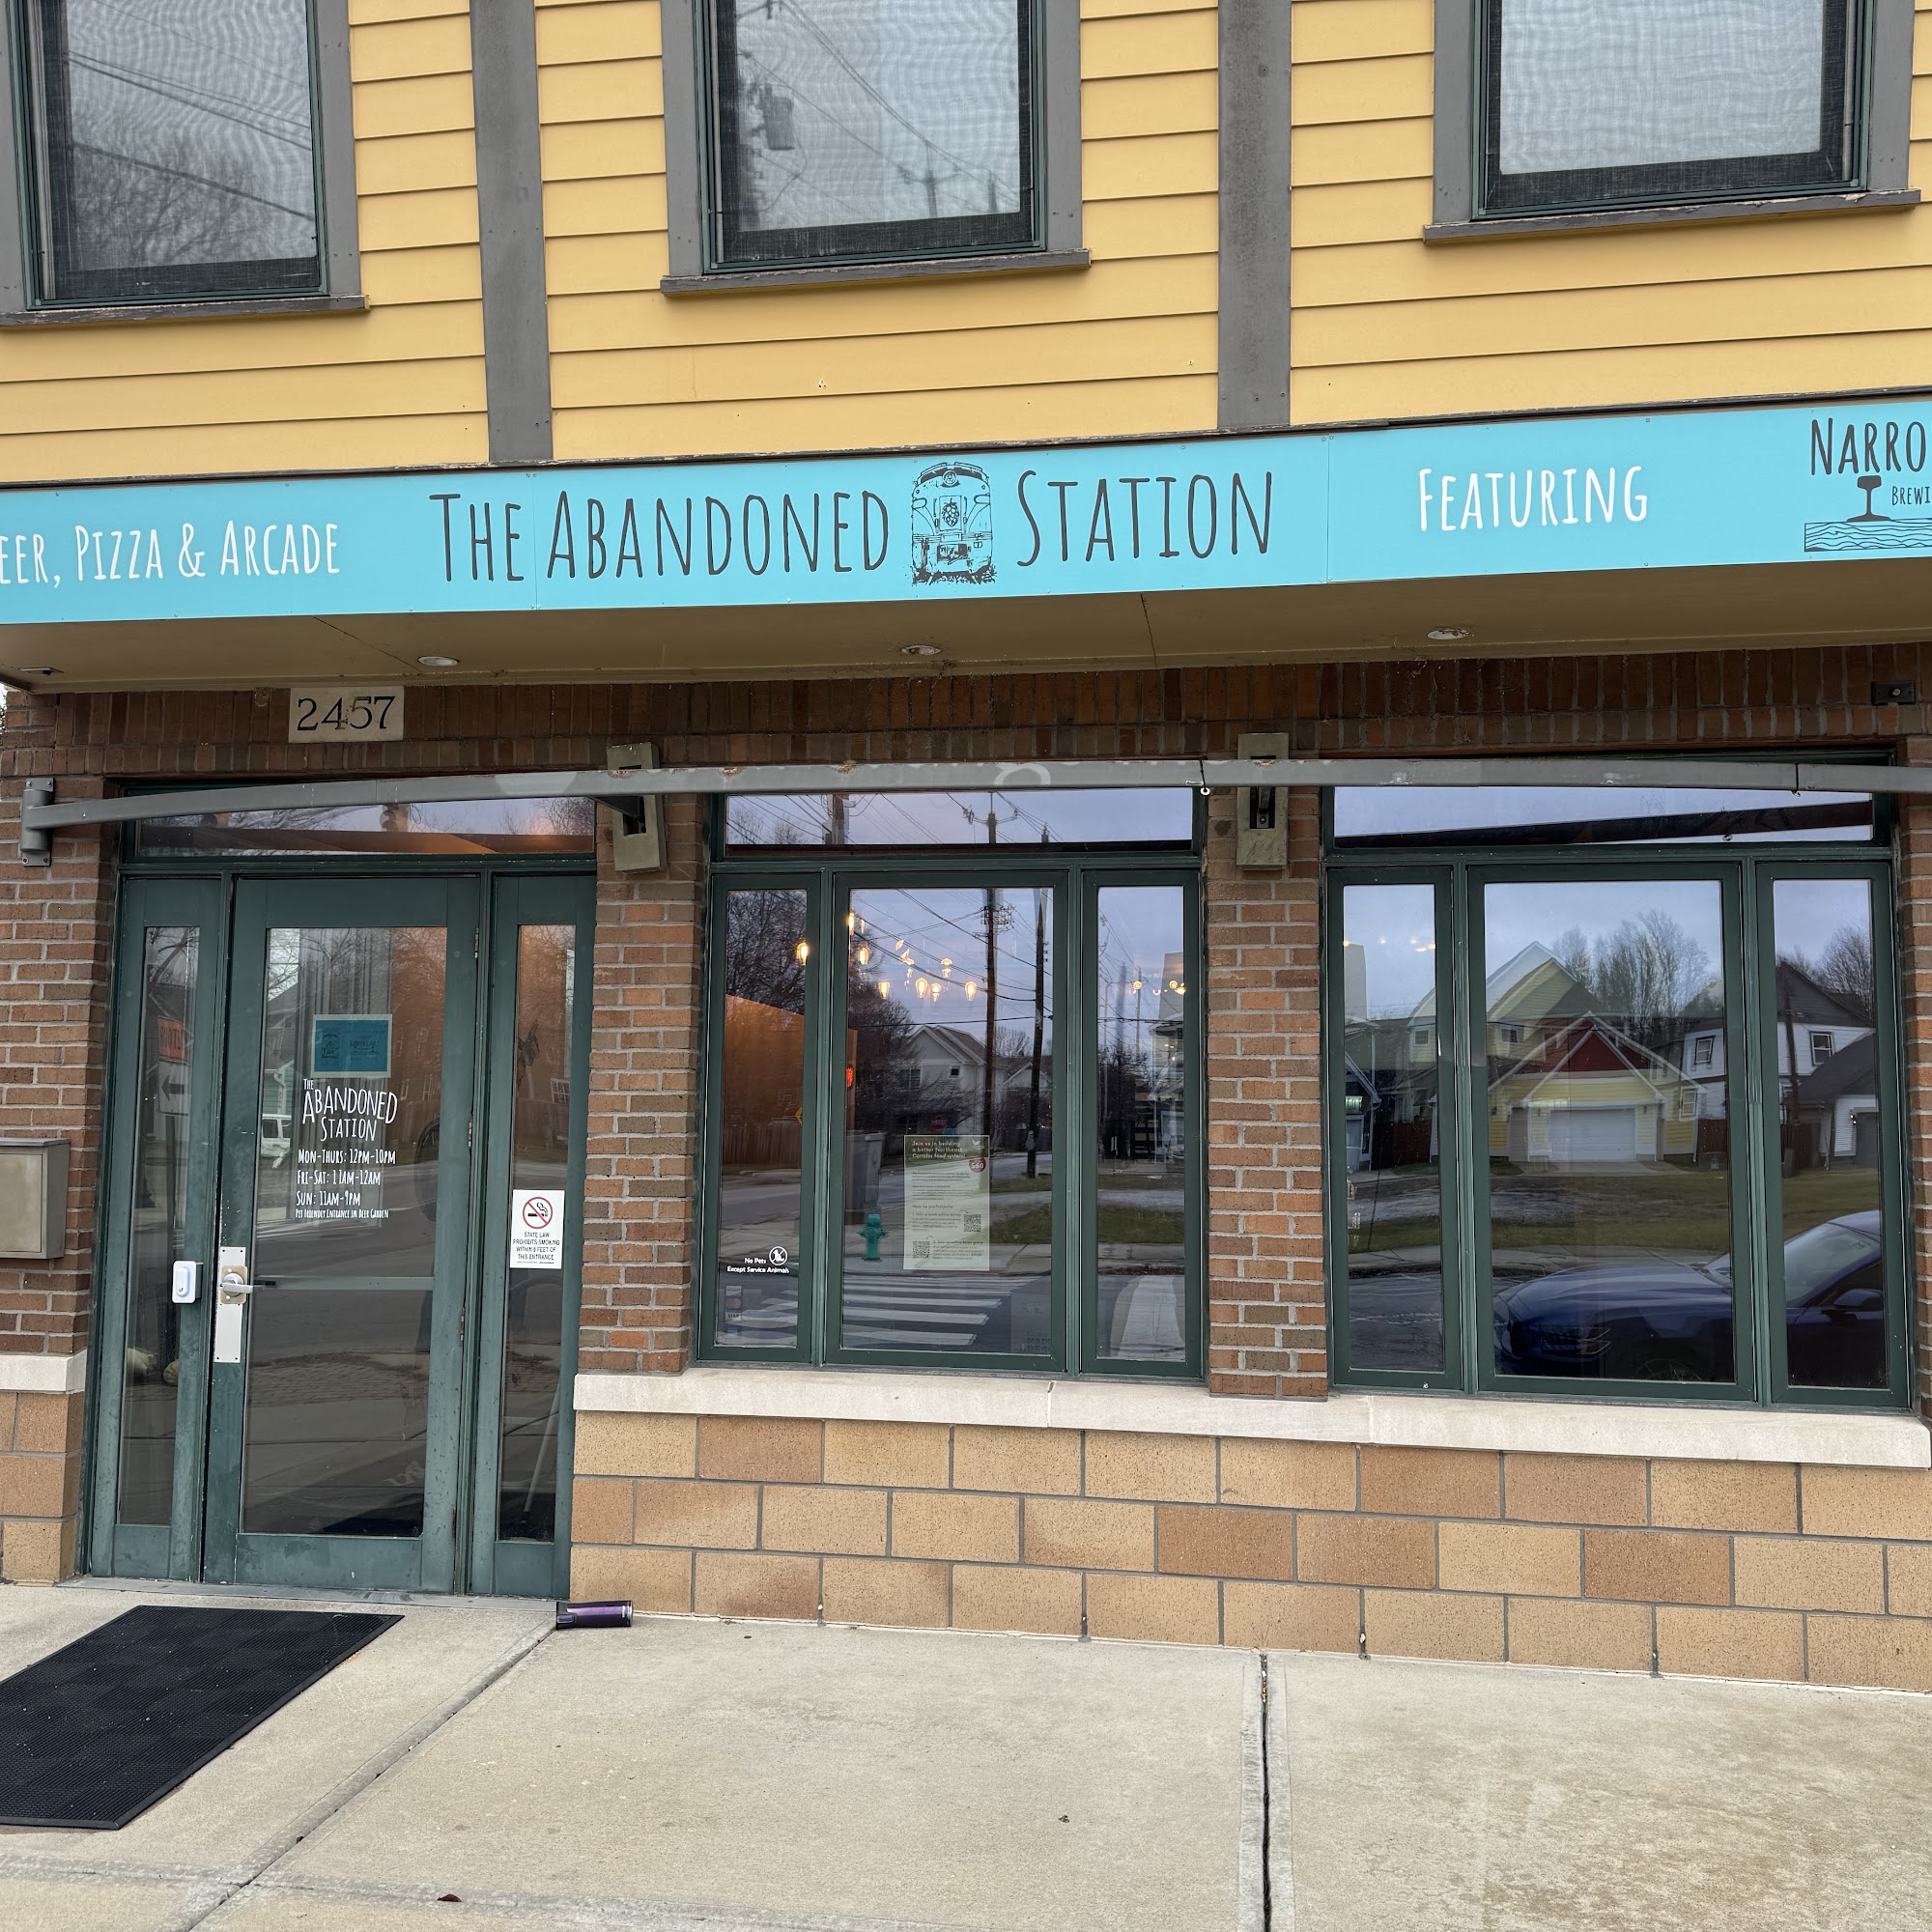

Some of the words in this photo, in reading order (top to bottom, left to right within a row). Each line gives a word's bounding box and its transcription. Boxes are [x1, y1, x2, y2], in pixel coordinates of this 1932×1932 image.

[1811, 417, 1926, 475] NARRO
[1417, 466, 1648, 531] FEATURING
[1891, 485, 1931, 506] BREWI
[429, 494, 524, 582] THE
[547, 491, 889, 579] ABANDONED
[1017, 470, 1271, 566] STATION
[74, 525, 163, 581] PIZZA
[178, 523, 206, 578] &
[219, 520, 340, 576] ARCADE
[297, 695, 395, 731] 2457
[303, 1079, 314, 1090] THE
[302, 1085, 398, 1125] ABANDONED
[320, 1116, 378, 1142] STATION
[298, 1149, 347, 1164] MON-THURS:
[350, 1149, 396, 1164] 12PM-10PM
[297, 1170, 329, 1184] FRI-SAT:
[296, 1190, 317, 1206] SUN:
[320, 1190, 361, 1207] 11AM-9PM
